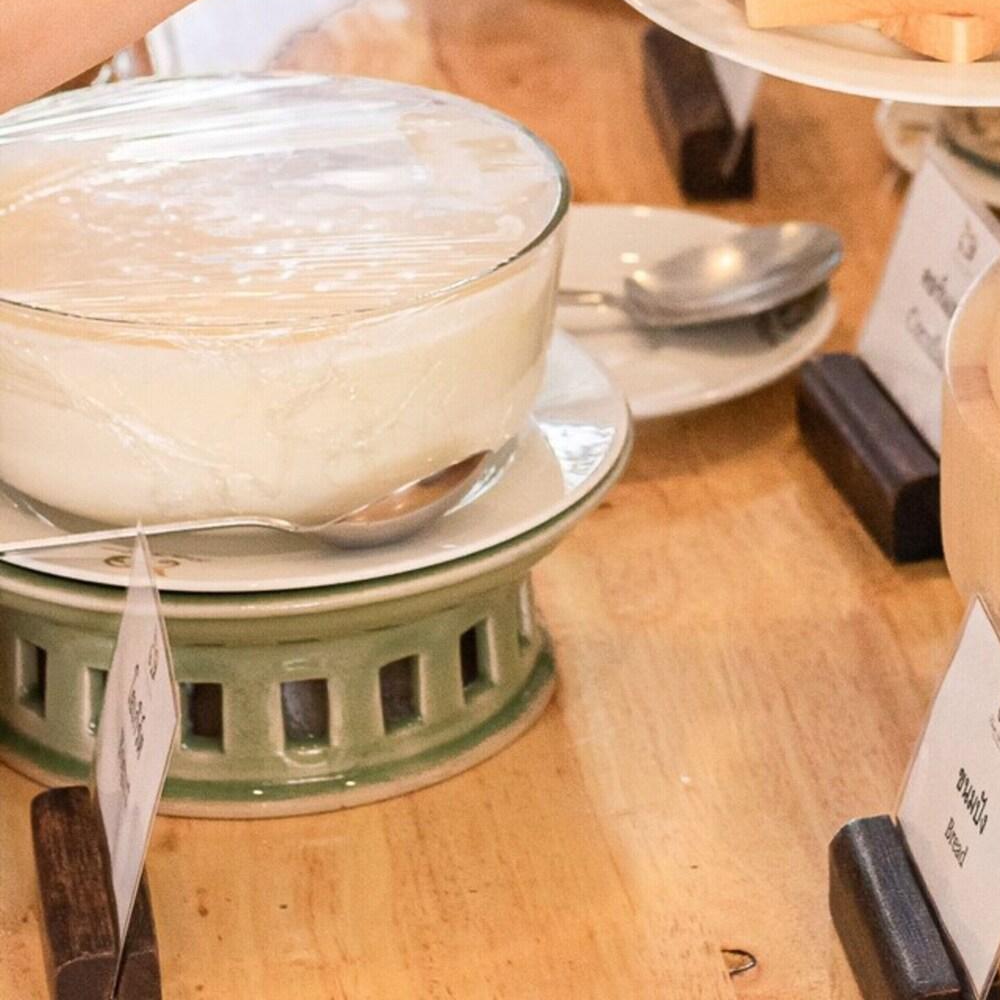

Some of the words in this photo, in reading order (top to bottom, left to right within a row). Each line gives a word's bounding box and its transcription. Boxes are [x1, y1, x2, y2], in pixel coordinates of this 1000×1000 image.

[956, 768, 988, 834] ขนมปัง
[945, 817, 968, 868] Bread
